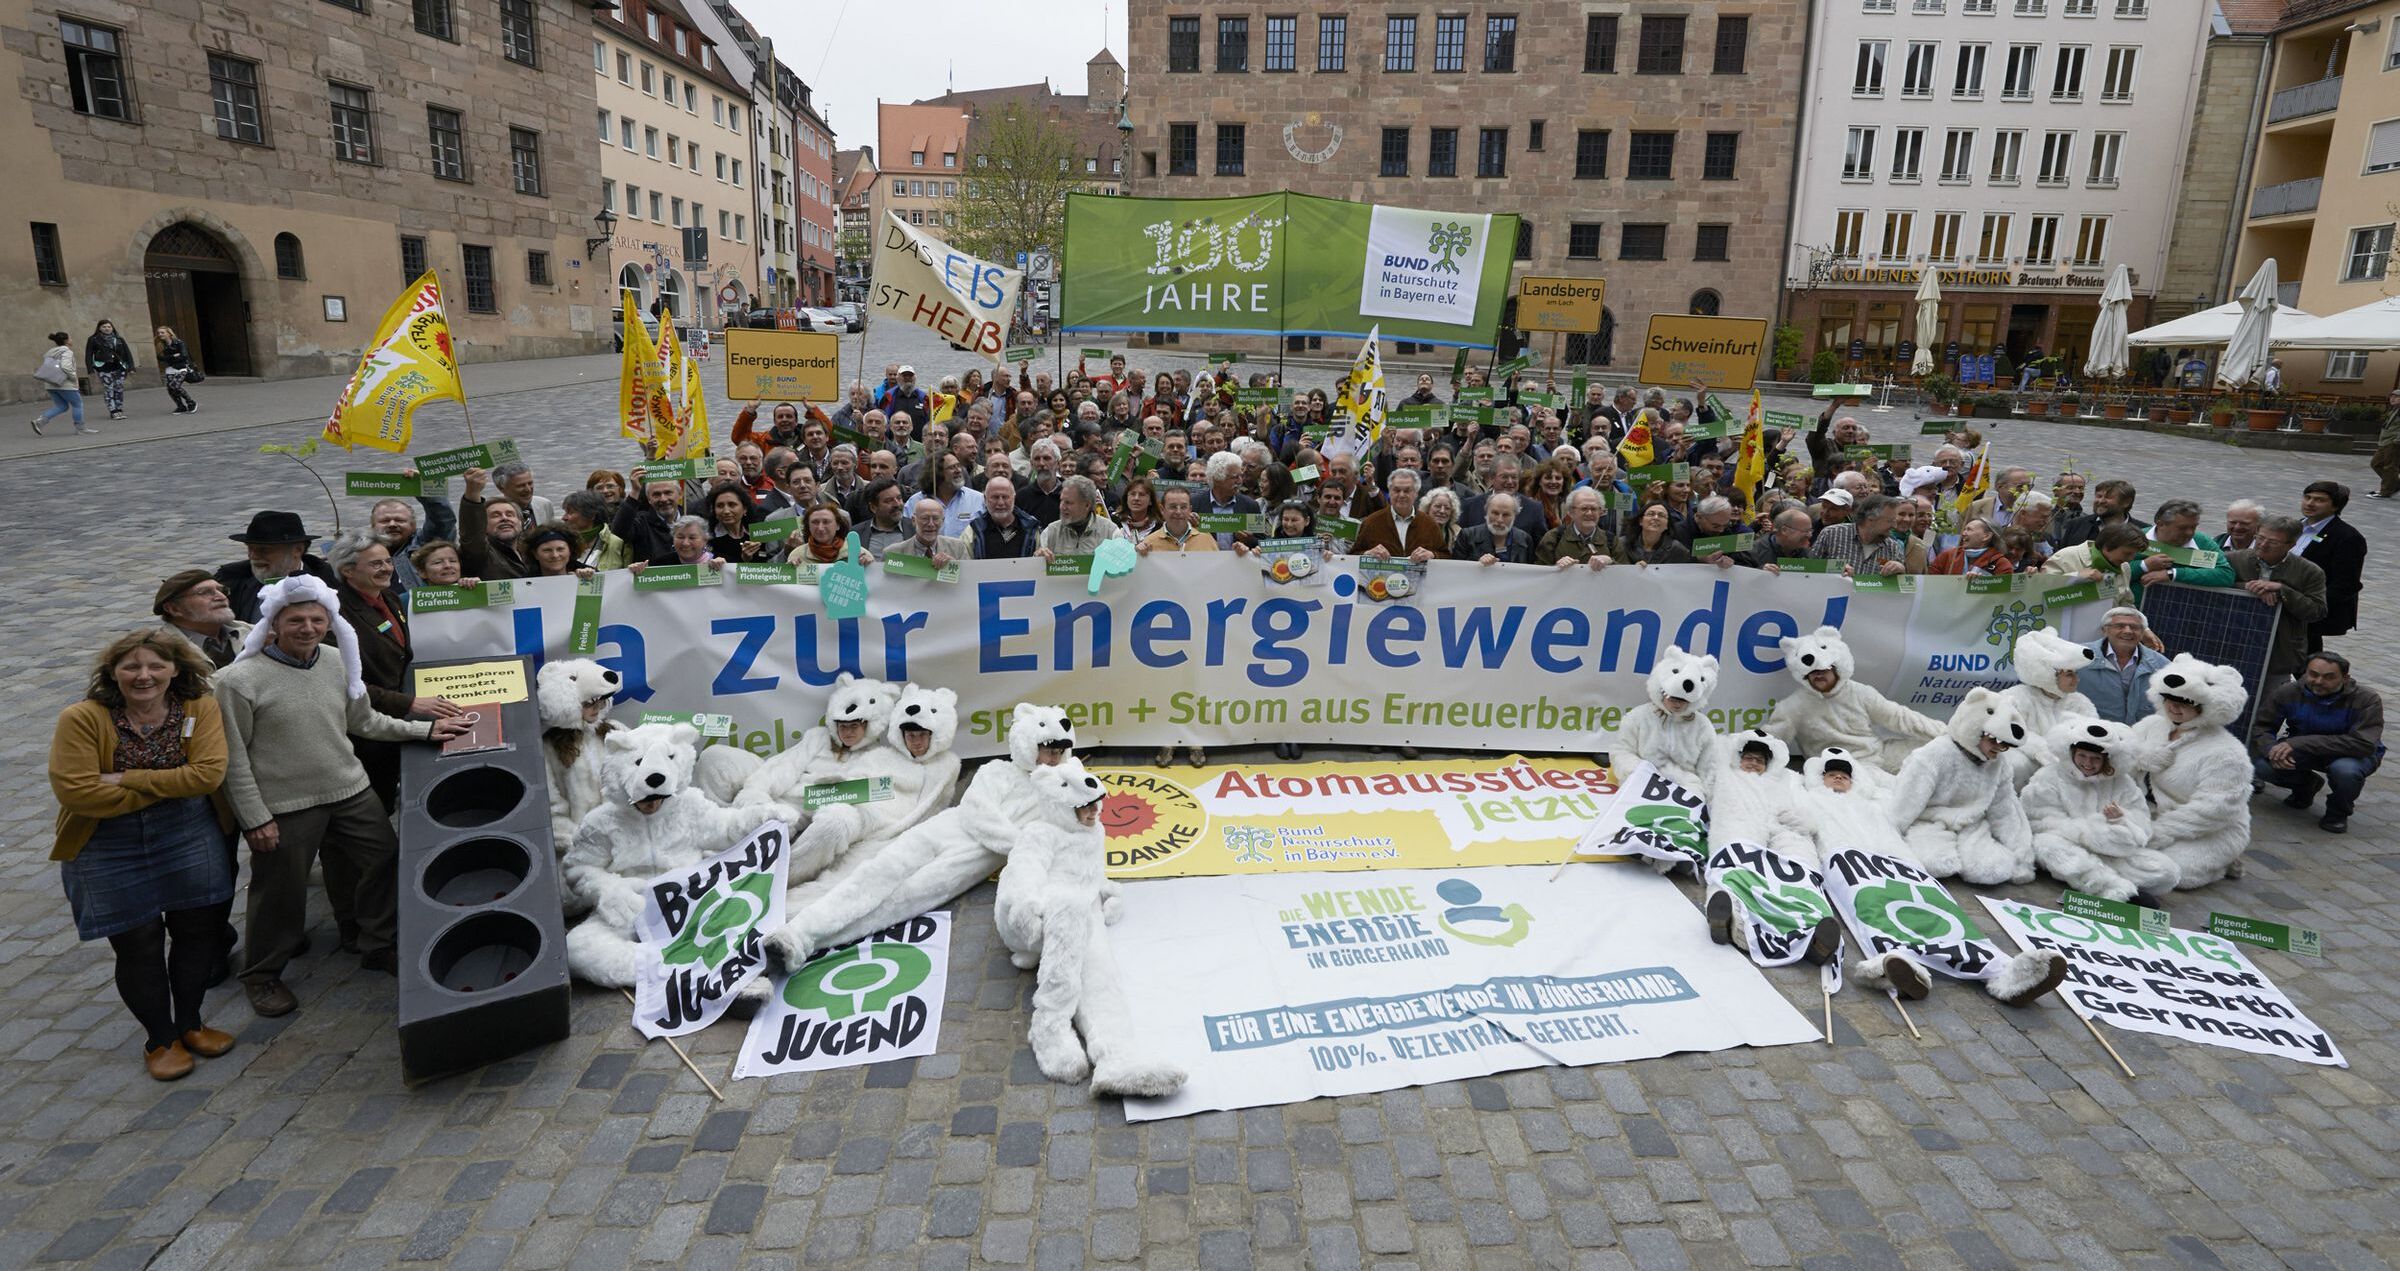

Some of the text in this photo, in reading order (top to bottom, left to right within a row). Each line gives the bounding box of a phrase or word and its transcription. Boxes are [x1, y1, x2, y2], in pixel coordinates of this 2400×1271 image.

[614, 236, 640, 251] ARIAT
[1144, 209, 1275, 275] 100
[885, 226, 1005, 309] DAS EIS
[1384, 254, 1429, 271] BUND
[1382, 271, 1459, 291] Naturschutz
[1831, 268, 2012, 286] GOLDENES OSTHORN
[872, 283, 909, 309] IST
[1143, 283, 1268, 314] JAHRE
[1380, 286, 1457, 306] in Bayern e.V.
[1523, 282, 1601, 302] Landsberg
[1650, 335, 1758, 356] Schweinfurt
[731, 352, 836, 371] Energiespardorf
[420, 450, 484, 468] Neustadt/Wald-
[424, 459, 480, 476] naab-Weiden
[643, 469, 682, 479] nterallgäu
[350, 480, 401, 490] Miltenberg
[752, 527, 782, 538] München
[740, 566, 782, 575] Wunsiedel/
[887, 559, 904, 568] Roth
[637, 572, 692, 583] Tirschenreuth
[740, 573, 792, 582] Fichtelgebirge
[416, 589, 457, 600] Freyung-
[416, 597, 460, 607] Grafenau
[578, 622, 592, 651] Freising
[710, 610, 930, 696] zur
[1928, 654, 1990, 672] BUND
[424, 669, 515, 684] Stromsparen
[446, 680, 497, 691] ersetzt
[1919, 676, 2022, 690] Naturschu
[437, 687, 508, 701] Atomkraft
[1910, 692, 1965, 706] in Bay
[642, 712, 676, 723] Jugend-
[1128, 698, 1157, 723] +
[1168, 691, 1287, 725] Strom
[1301, 697, 1371, 724] aus
[1383, 692, 1634, 732] Erneuerbare
[1214, 758, 1618, 799] Atomausstieg
[807, 788, 839, 798] Jugend-
[808, 792, 858, 806] organisation
[1457, 792, 1600, 831] jetzt!
[1278, 826, 1324, 836] Bund
[1107, 824, 1199, 866] DANKE
[1282, 836, 1392, 849] Naturschutz
[1285, 847, 1400, 863] in Bayern e.V.
[653, 829, 783, 937] BUND
[1279, 885, 1427, 923] DIE WENDE
[2068, 895, 2104, 910] Jugend-
[2068, 904, 2126, 923] organisation
[2213, 916, 2251, 930] Jugend-
[2213, 925, 2274, 944] organisation
[1332, 938, 1451, 967] BÜRGERHAND
[2146, 976, 2295, 1021] Earth
[1216, 970, 1683, 1047] FÜR EINE ENERGIEWENDE IN BÜRGERHAND:
[762, 996, 928, 1065] JUGEND
[1527, 1013, 1639, 1046] GERECHT.
[2072, 989, 2334, 1059] Germany
